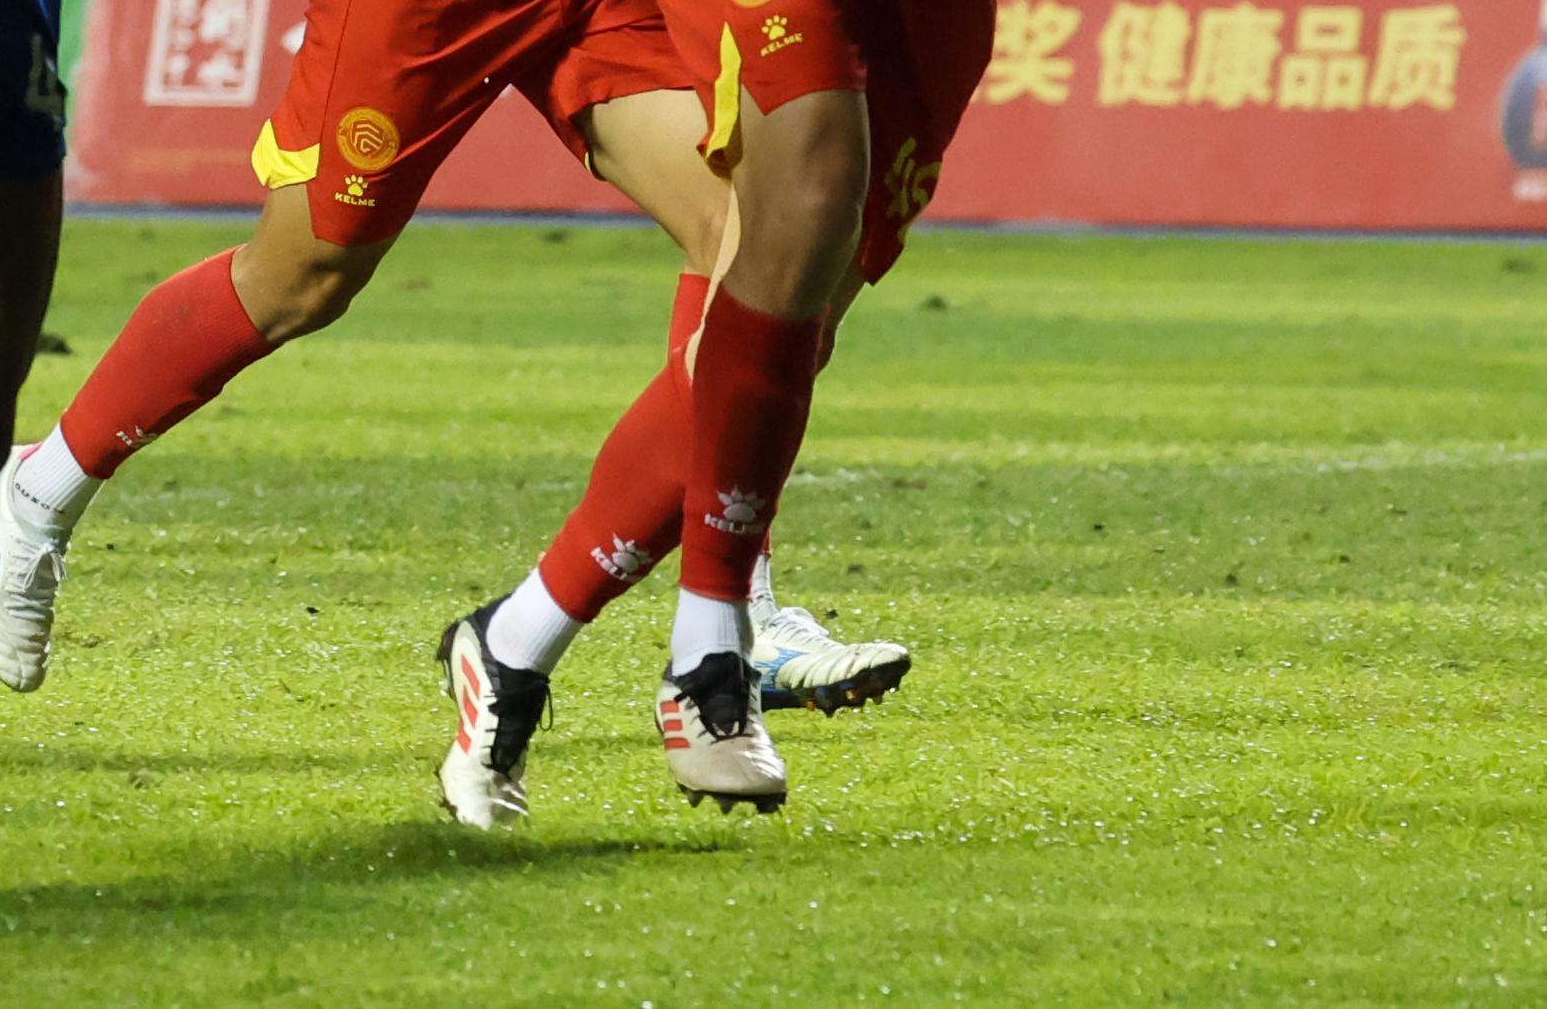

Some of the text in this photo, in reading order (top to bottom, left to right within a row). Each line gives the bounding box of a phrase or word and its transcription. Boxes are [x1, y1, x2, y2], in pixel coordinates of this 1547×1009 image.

[1098, 0, 1467, 112] 健康品质
[334, 192, 376, 207] KELME
